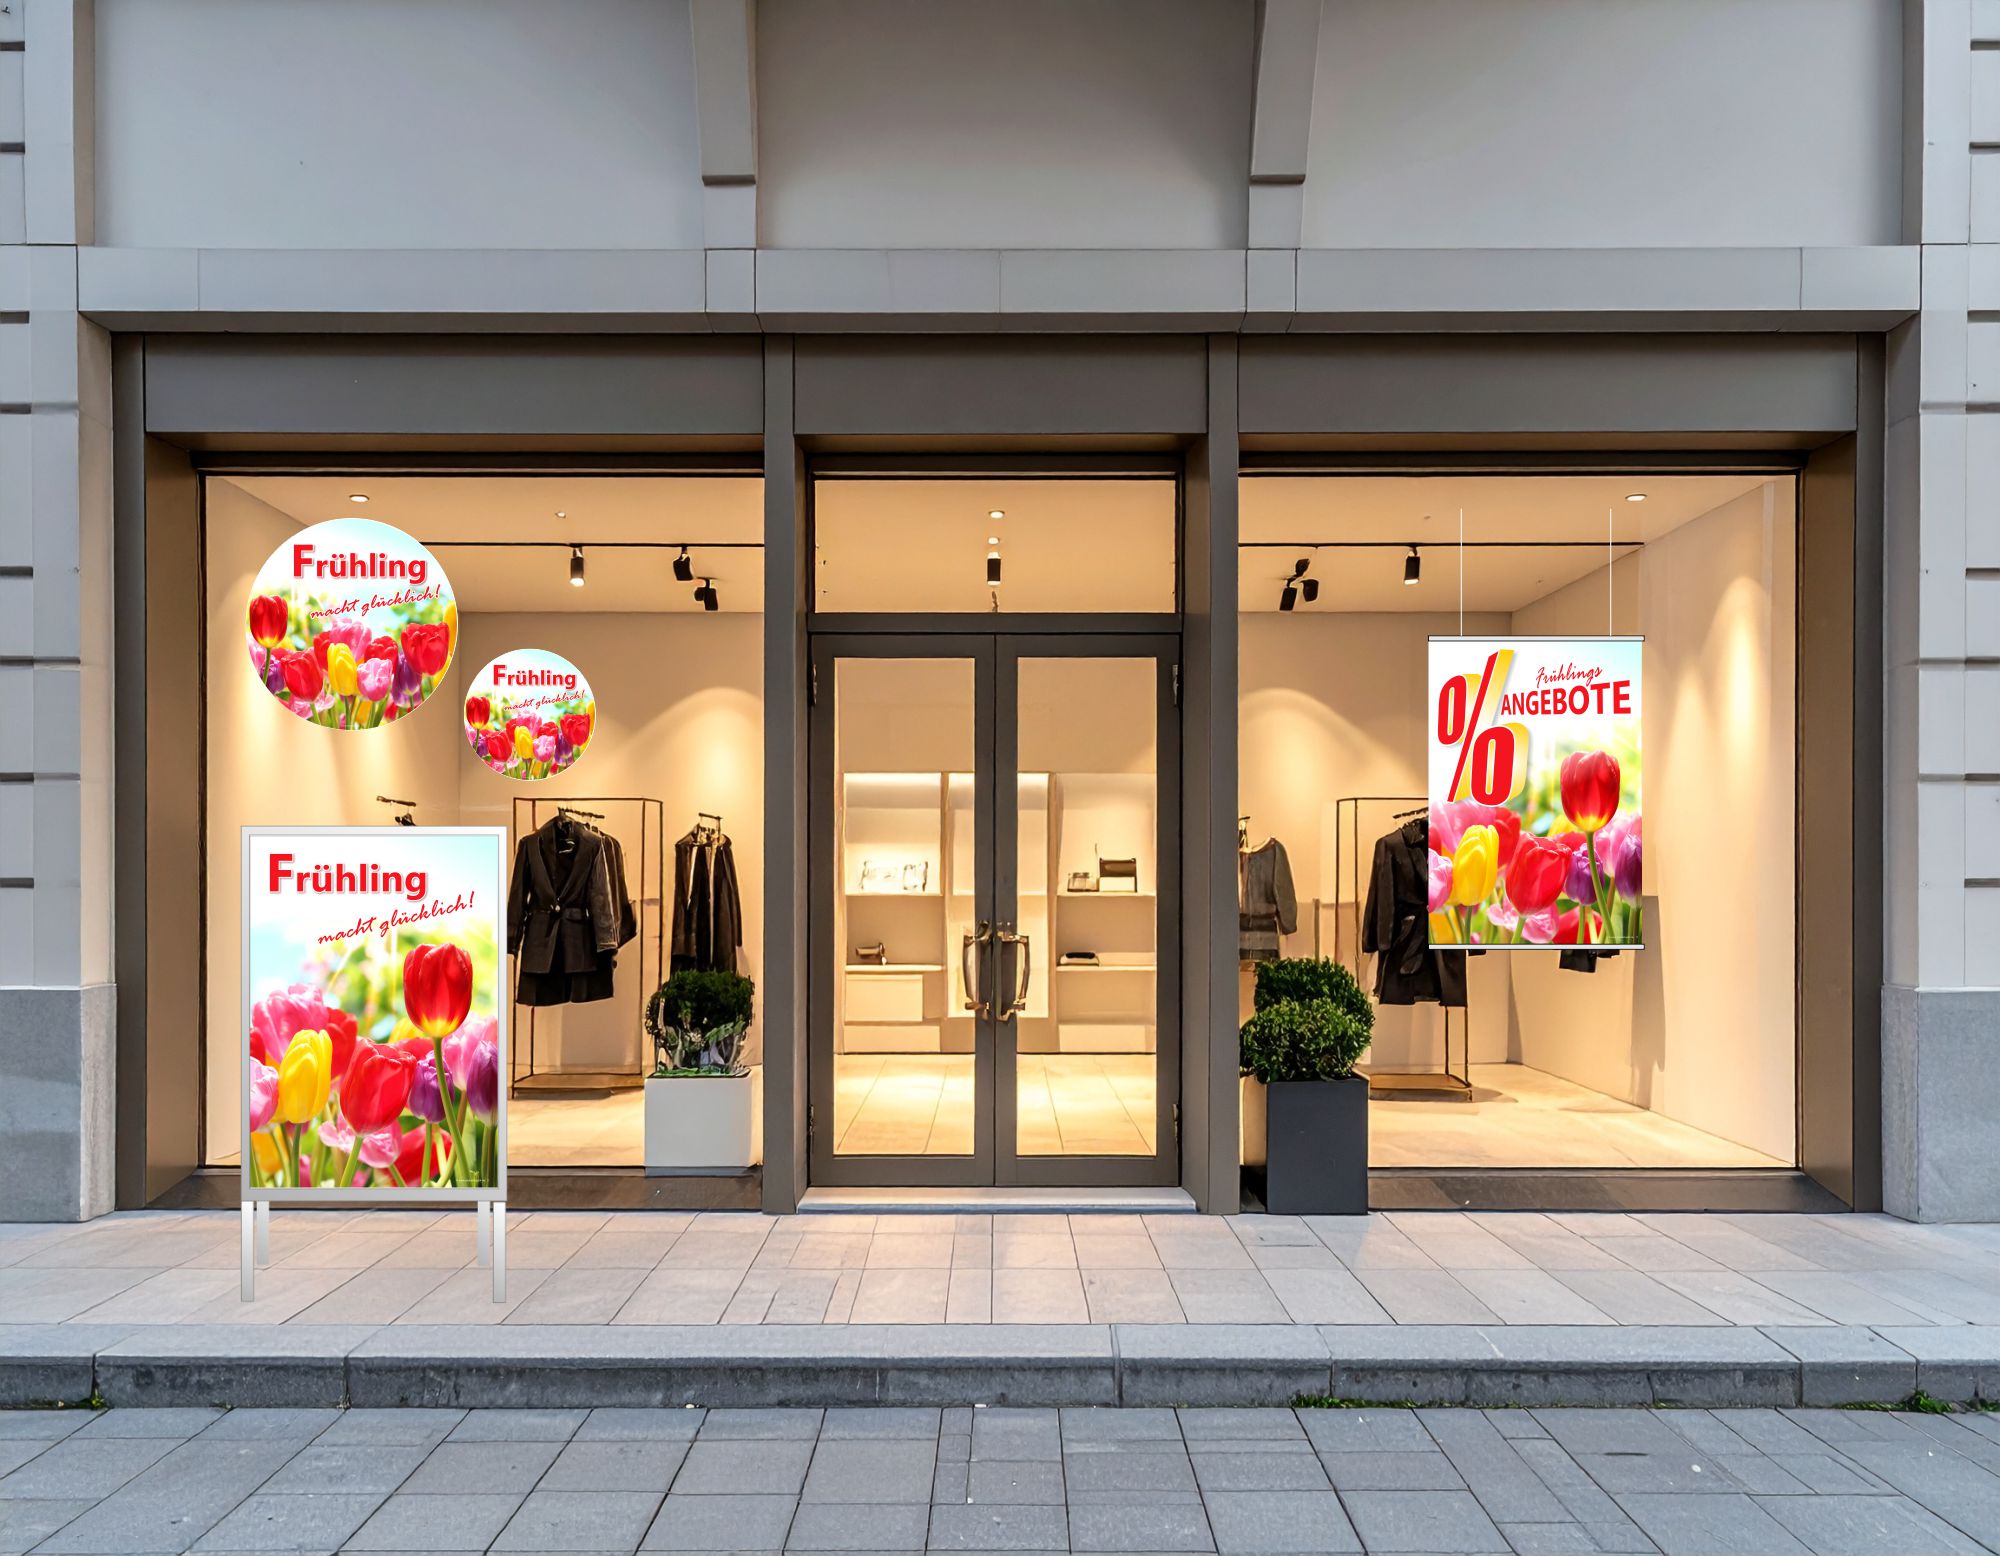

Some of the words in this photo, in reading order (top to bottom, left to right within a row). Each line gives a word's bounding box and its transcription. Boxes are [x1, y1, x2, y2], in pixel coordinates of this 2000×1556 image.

[293, 544, 427, 585] Frühling
[310, 599, 360, 619] macht
[361, 584, 441, 617] glücklich!
[493, 664, 577, 691] Frühling
[1535, 662, 1603, 689] Frühlings
[503, 698, 535, 711] macht
[535, 689, 586, 710] glücklich!
[1500, 680, 1632, 716] ANGEBOTE
[1437, 649, 1529, 807] %
[269, 853, 428, 902] Frühling
[317, 916, 378, 945] macht
[379, 891, 475, 938] glücklich!
